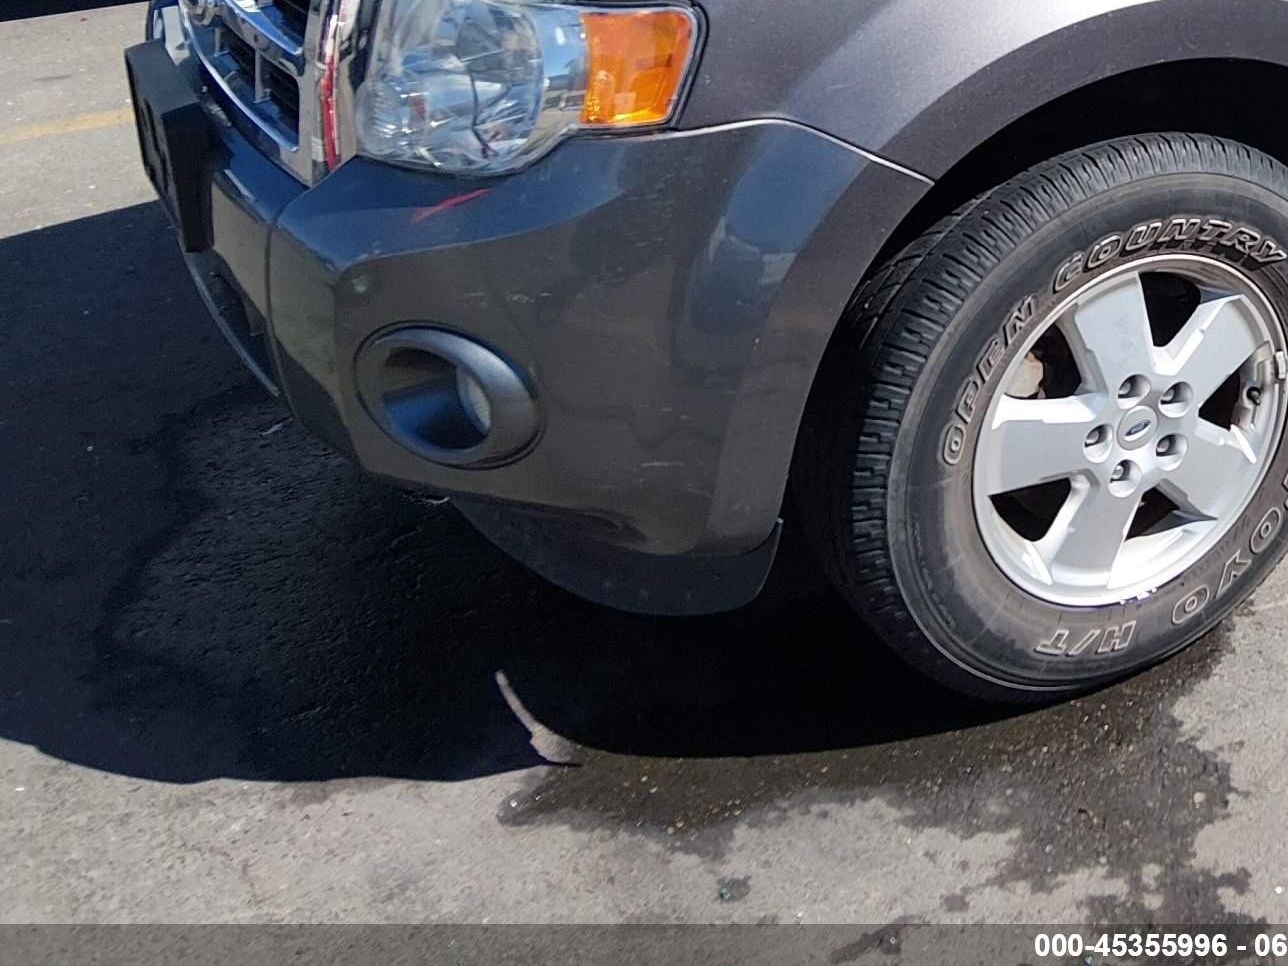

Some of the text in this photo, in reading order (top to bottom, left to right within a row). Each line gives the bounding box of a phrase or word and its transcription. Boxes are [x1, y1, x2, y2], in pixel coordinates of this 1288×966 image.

[944, 215, 1288, 465] OPEN COUNTRY
[1034, 620, 1138, 656] H/T
